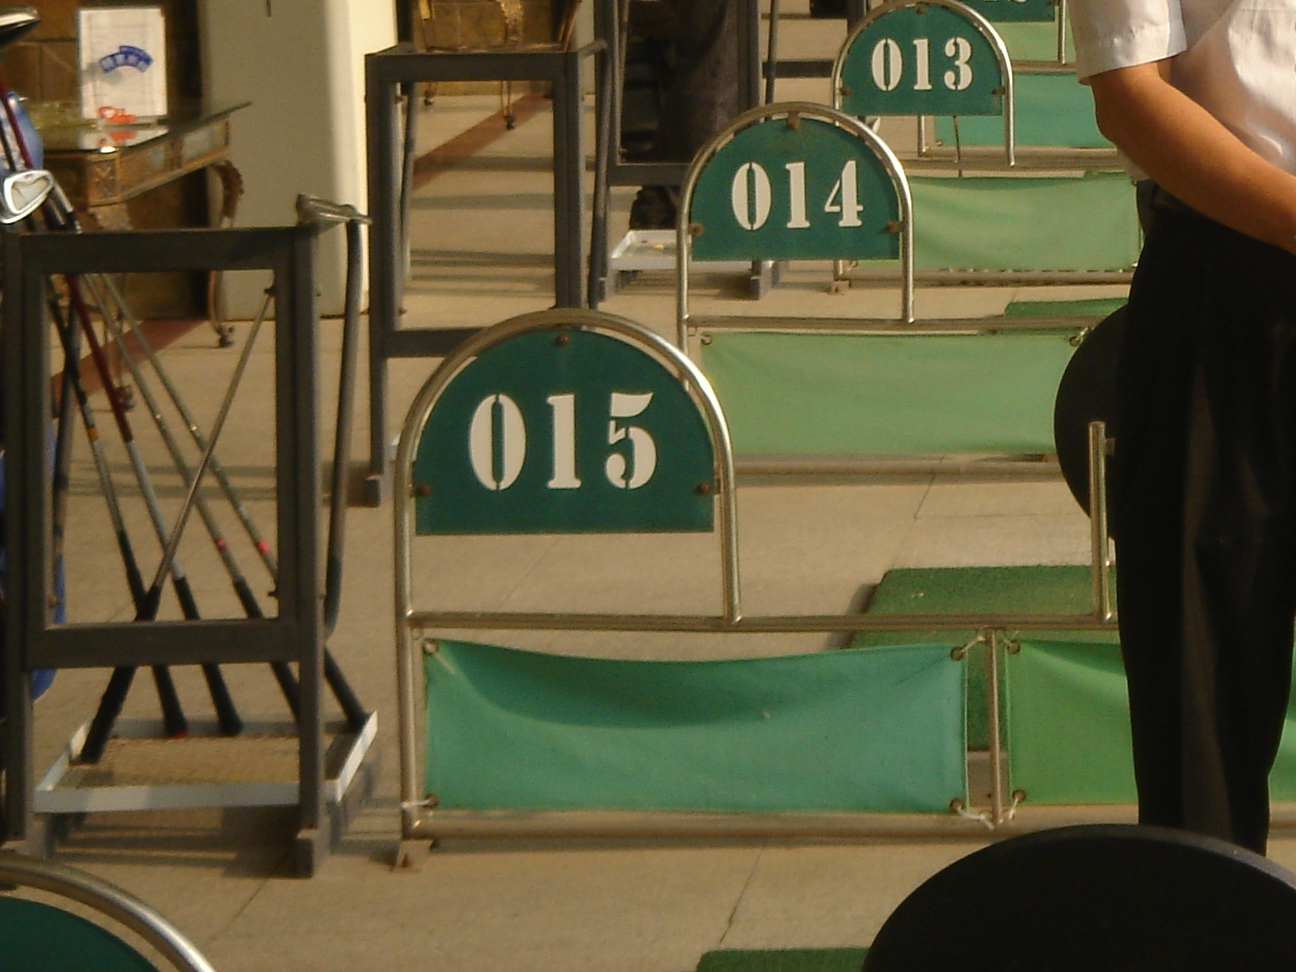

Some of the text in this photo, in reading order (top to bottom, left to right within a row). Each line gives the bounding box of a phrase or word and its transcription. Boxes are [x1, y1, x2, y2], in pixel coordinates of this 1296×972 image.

[871, 37, 973, 91] 013
[732, 160, 864, 230] 014
[468, 392, 657, 491] 015
